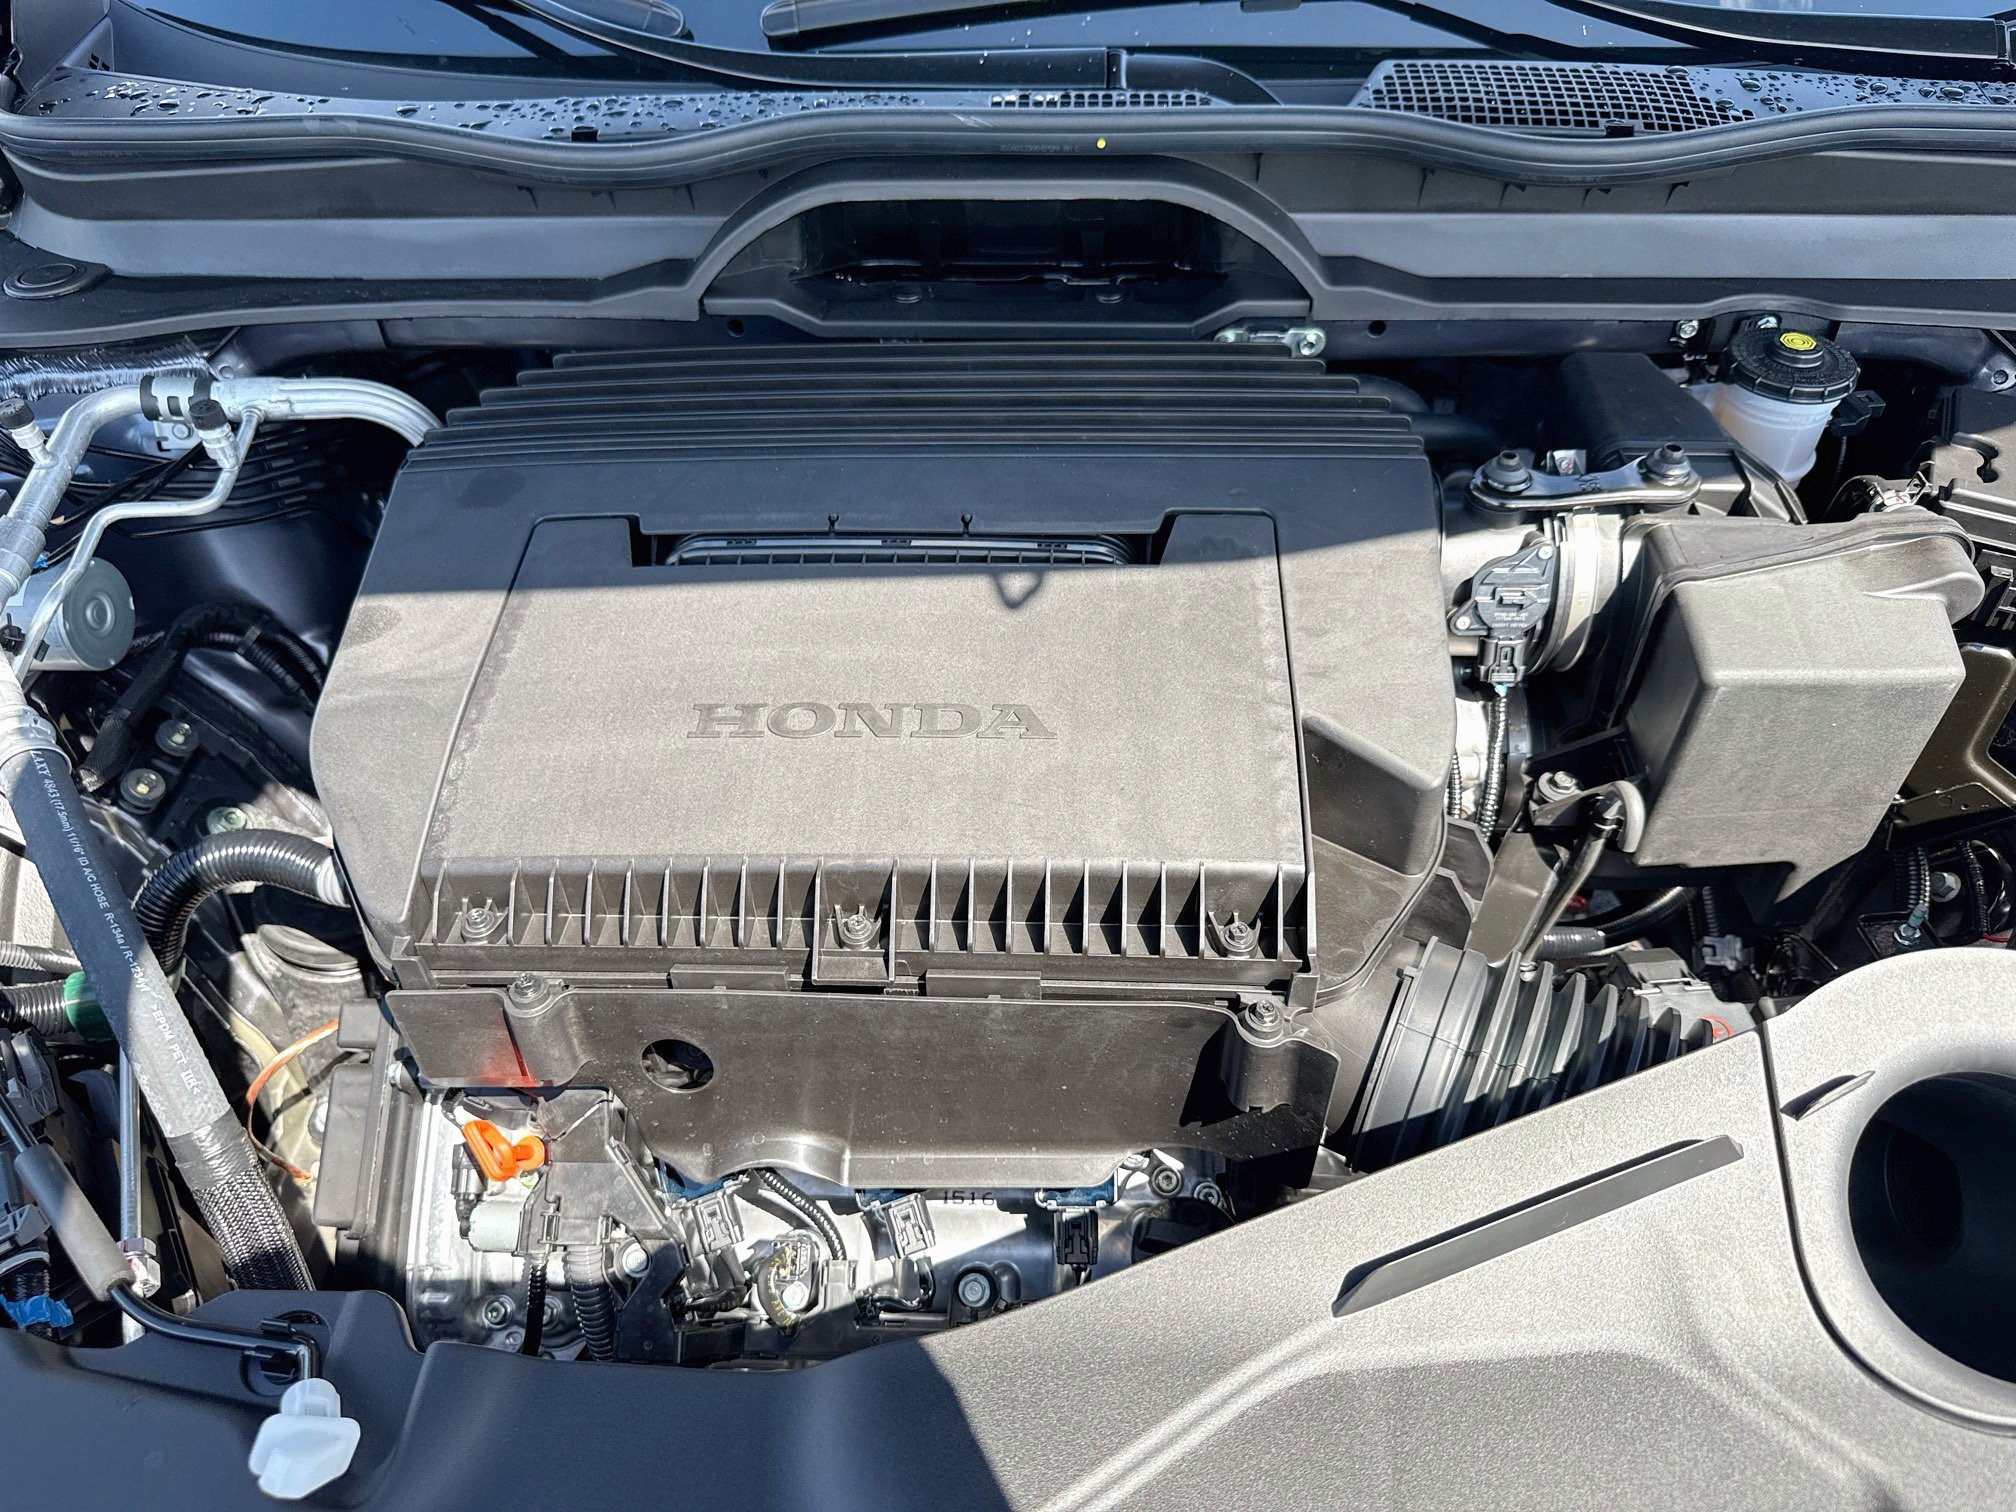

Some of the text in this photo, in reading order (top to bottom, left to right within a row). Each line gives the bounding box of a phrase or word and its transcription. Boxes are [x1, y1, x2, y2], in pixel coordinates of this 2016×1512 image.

[686, 702, 1057, 740] HONDA
[43, 778, 60, 798] 4843
[50, 799, 74, 832] (17.5mm)
[78, 856, 89, 866] ID
[83, 867, 97, 883] A/C
[90, 883, 110, 910] HOSE
[104, 912, 125, 945] R-134a
[123, 949, 151, 992] R-1234yf
[170, 1043, 188, 1065] PET
[943, 1190, 994, 1206] 1516
